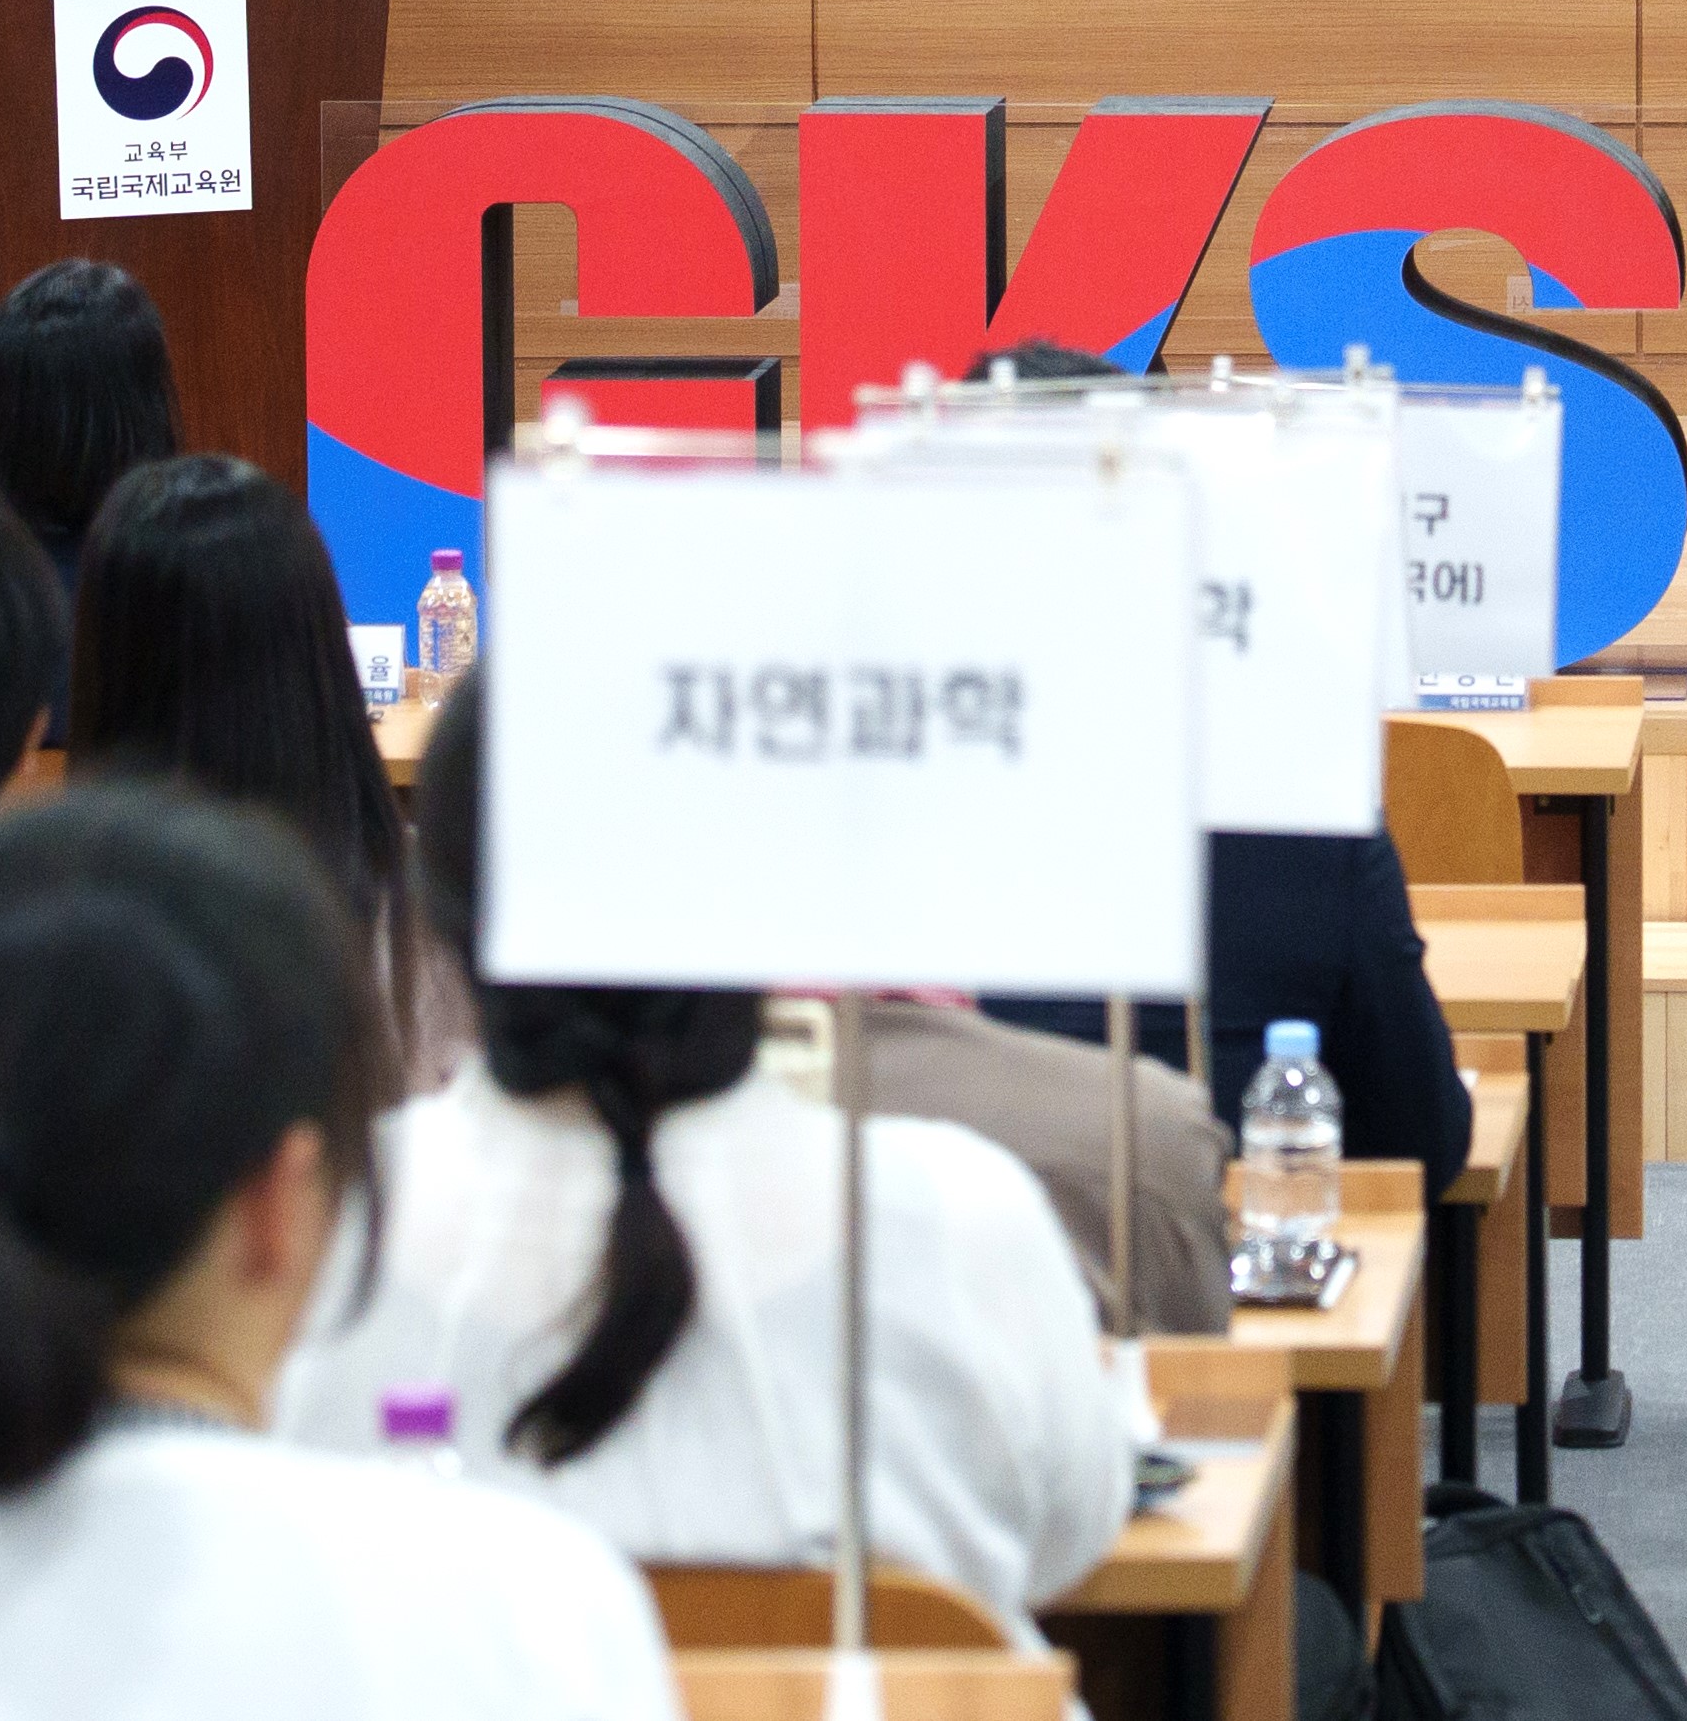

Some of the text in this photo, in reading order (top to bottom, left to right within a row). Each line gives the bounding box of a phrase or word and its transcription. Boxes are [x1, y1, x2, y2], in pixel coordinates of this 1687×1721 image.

[124, 140, 189, 163] 교육부
[71, 168, 242, 201] 국립국제교육원
[652, 657, 1028, 763] 자연과학
